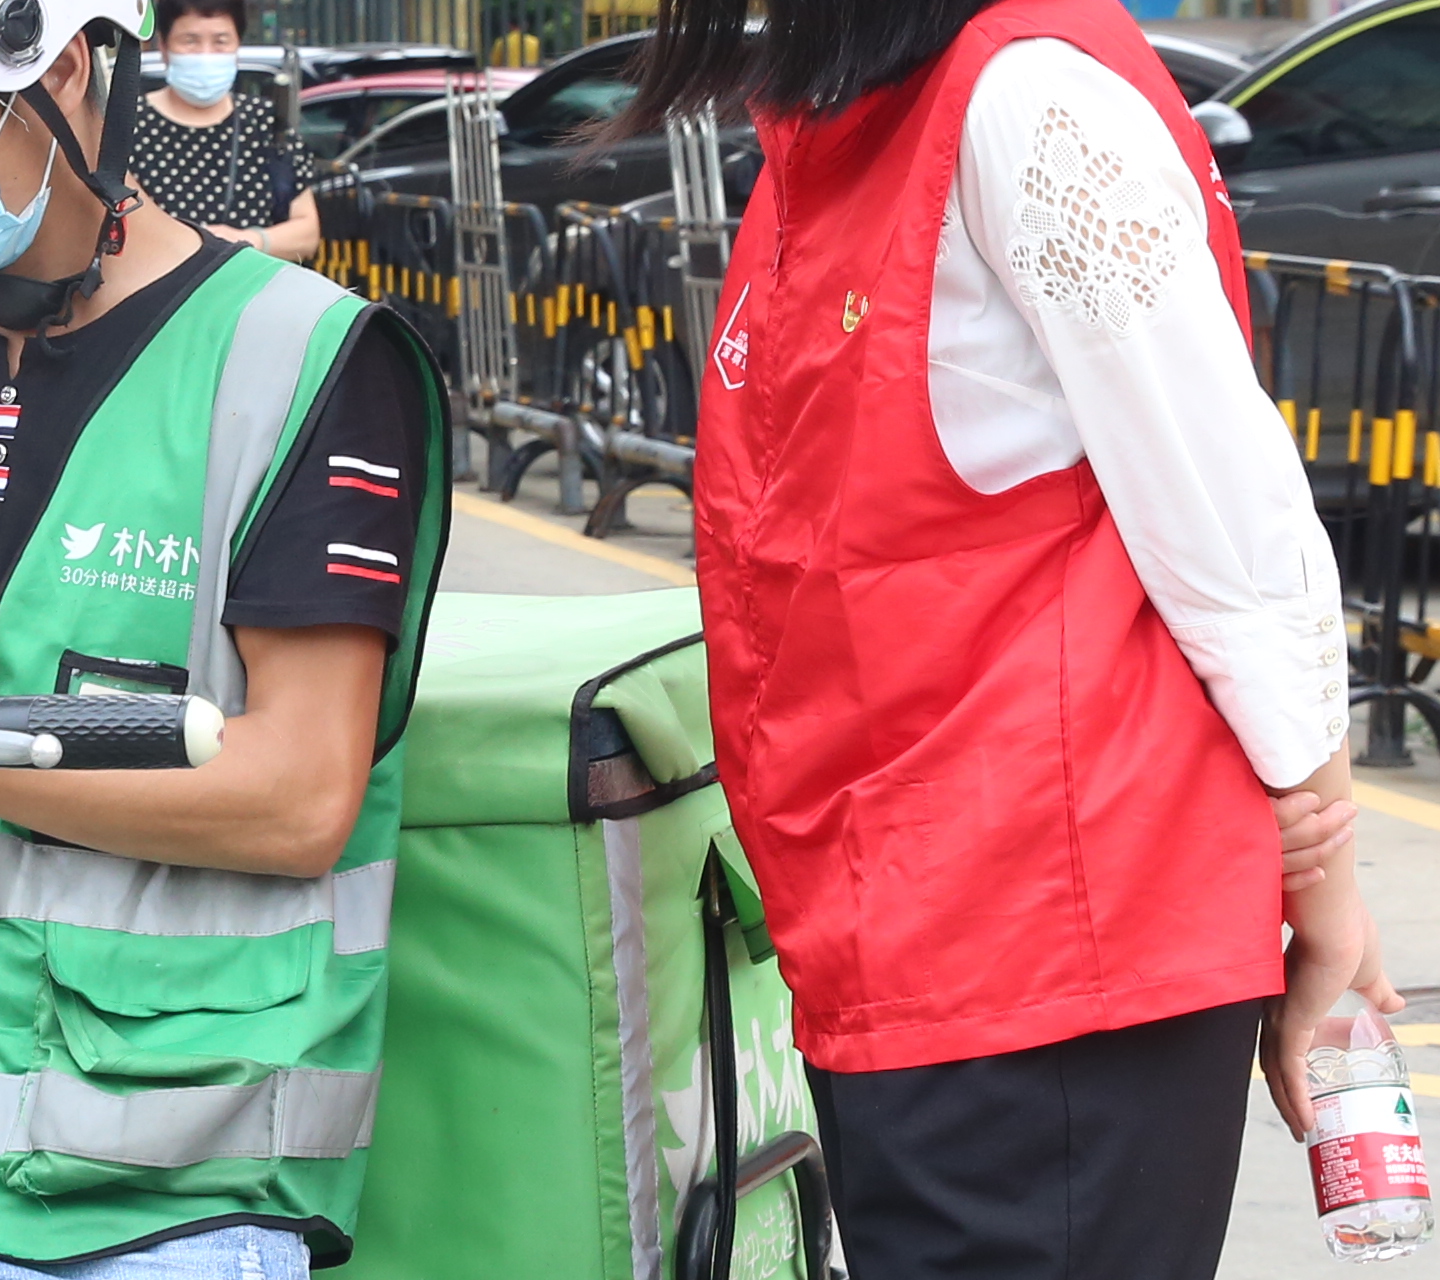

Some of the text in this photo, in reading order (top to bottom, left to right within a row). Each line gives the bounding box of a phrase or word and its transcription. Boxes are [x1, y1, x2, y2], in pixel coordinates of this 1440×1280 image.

[108, 526, 200, 577] 朴朴
[59, 565, 197, 601] 30分钟快送超市
